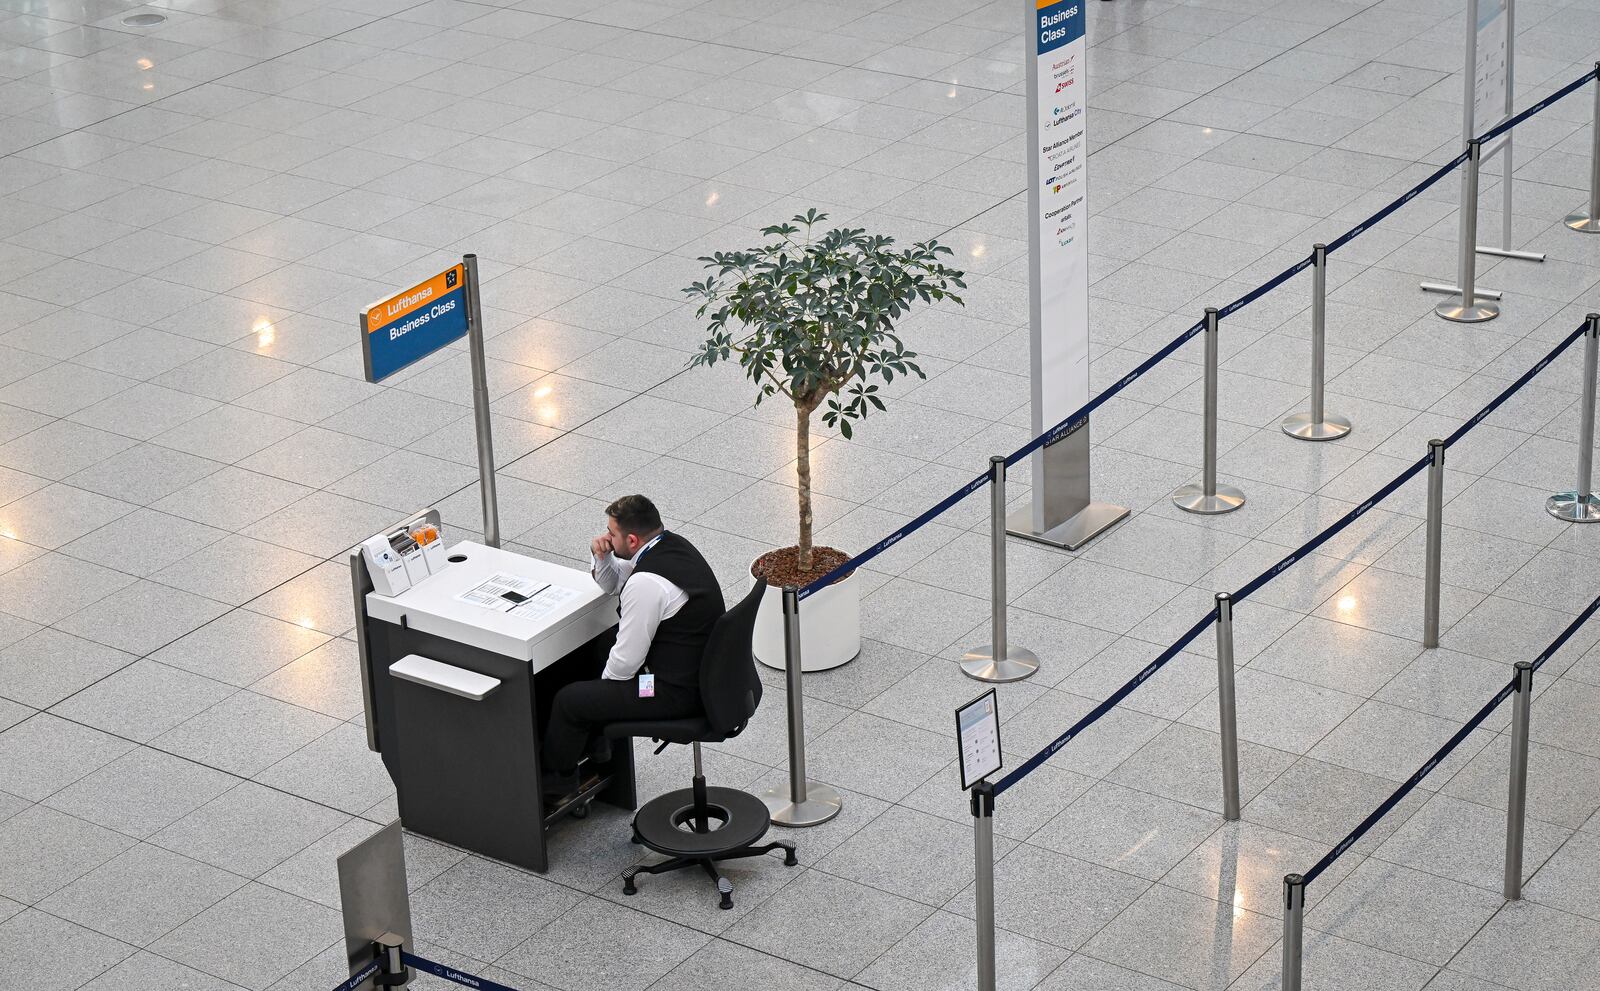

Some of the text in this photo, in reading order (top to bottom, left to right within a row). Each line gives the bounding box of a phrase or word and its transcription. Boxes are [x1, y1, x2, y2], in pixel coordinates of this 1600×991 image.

[1041, 5, 1078, 29] Business
[1041, 27, 1066, 44] Class
[1053, 112, 1074, 127] Lufthansa
[1042, 145, 1053, 154] Star
[1046, 176, 1056, 186] LOT
[1045, 203, 1071, 220] Cooperation
[387, 286, 433, 317] Lufthansa
[389, 299, 456, 341] Business Class
[1052, 422, 1069, 435] Lufthansa
[1060, 418, 1084, 438] ALLIANCE
[883, 532, 903, 548] Lufthansa
[1277, 556, 1295, 571] Lufthansa
[1051, 734, 1071, 752] Lufthansa
[350, 964, 379, 988] Lufthansa
[446, 970, 480, 987] Lufthansa
